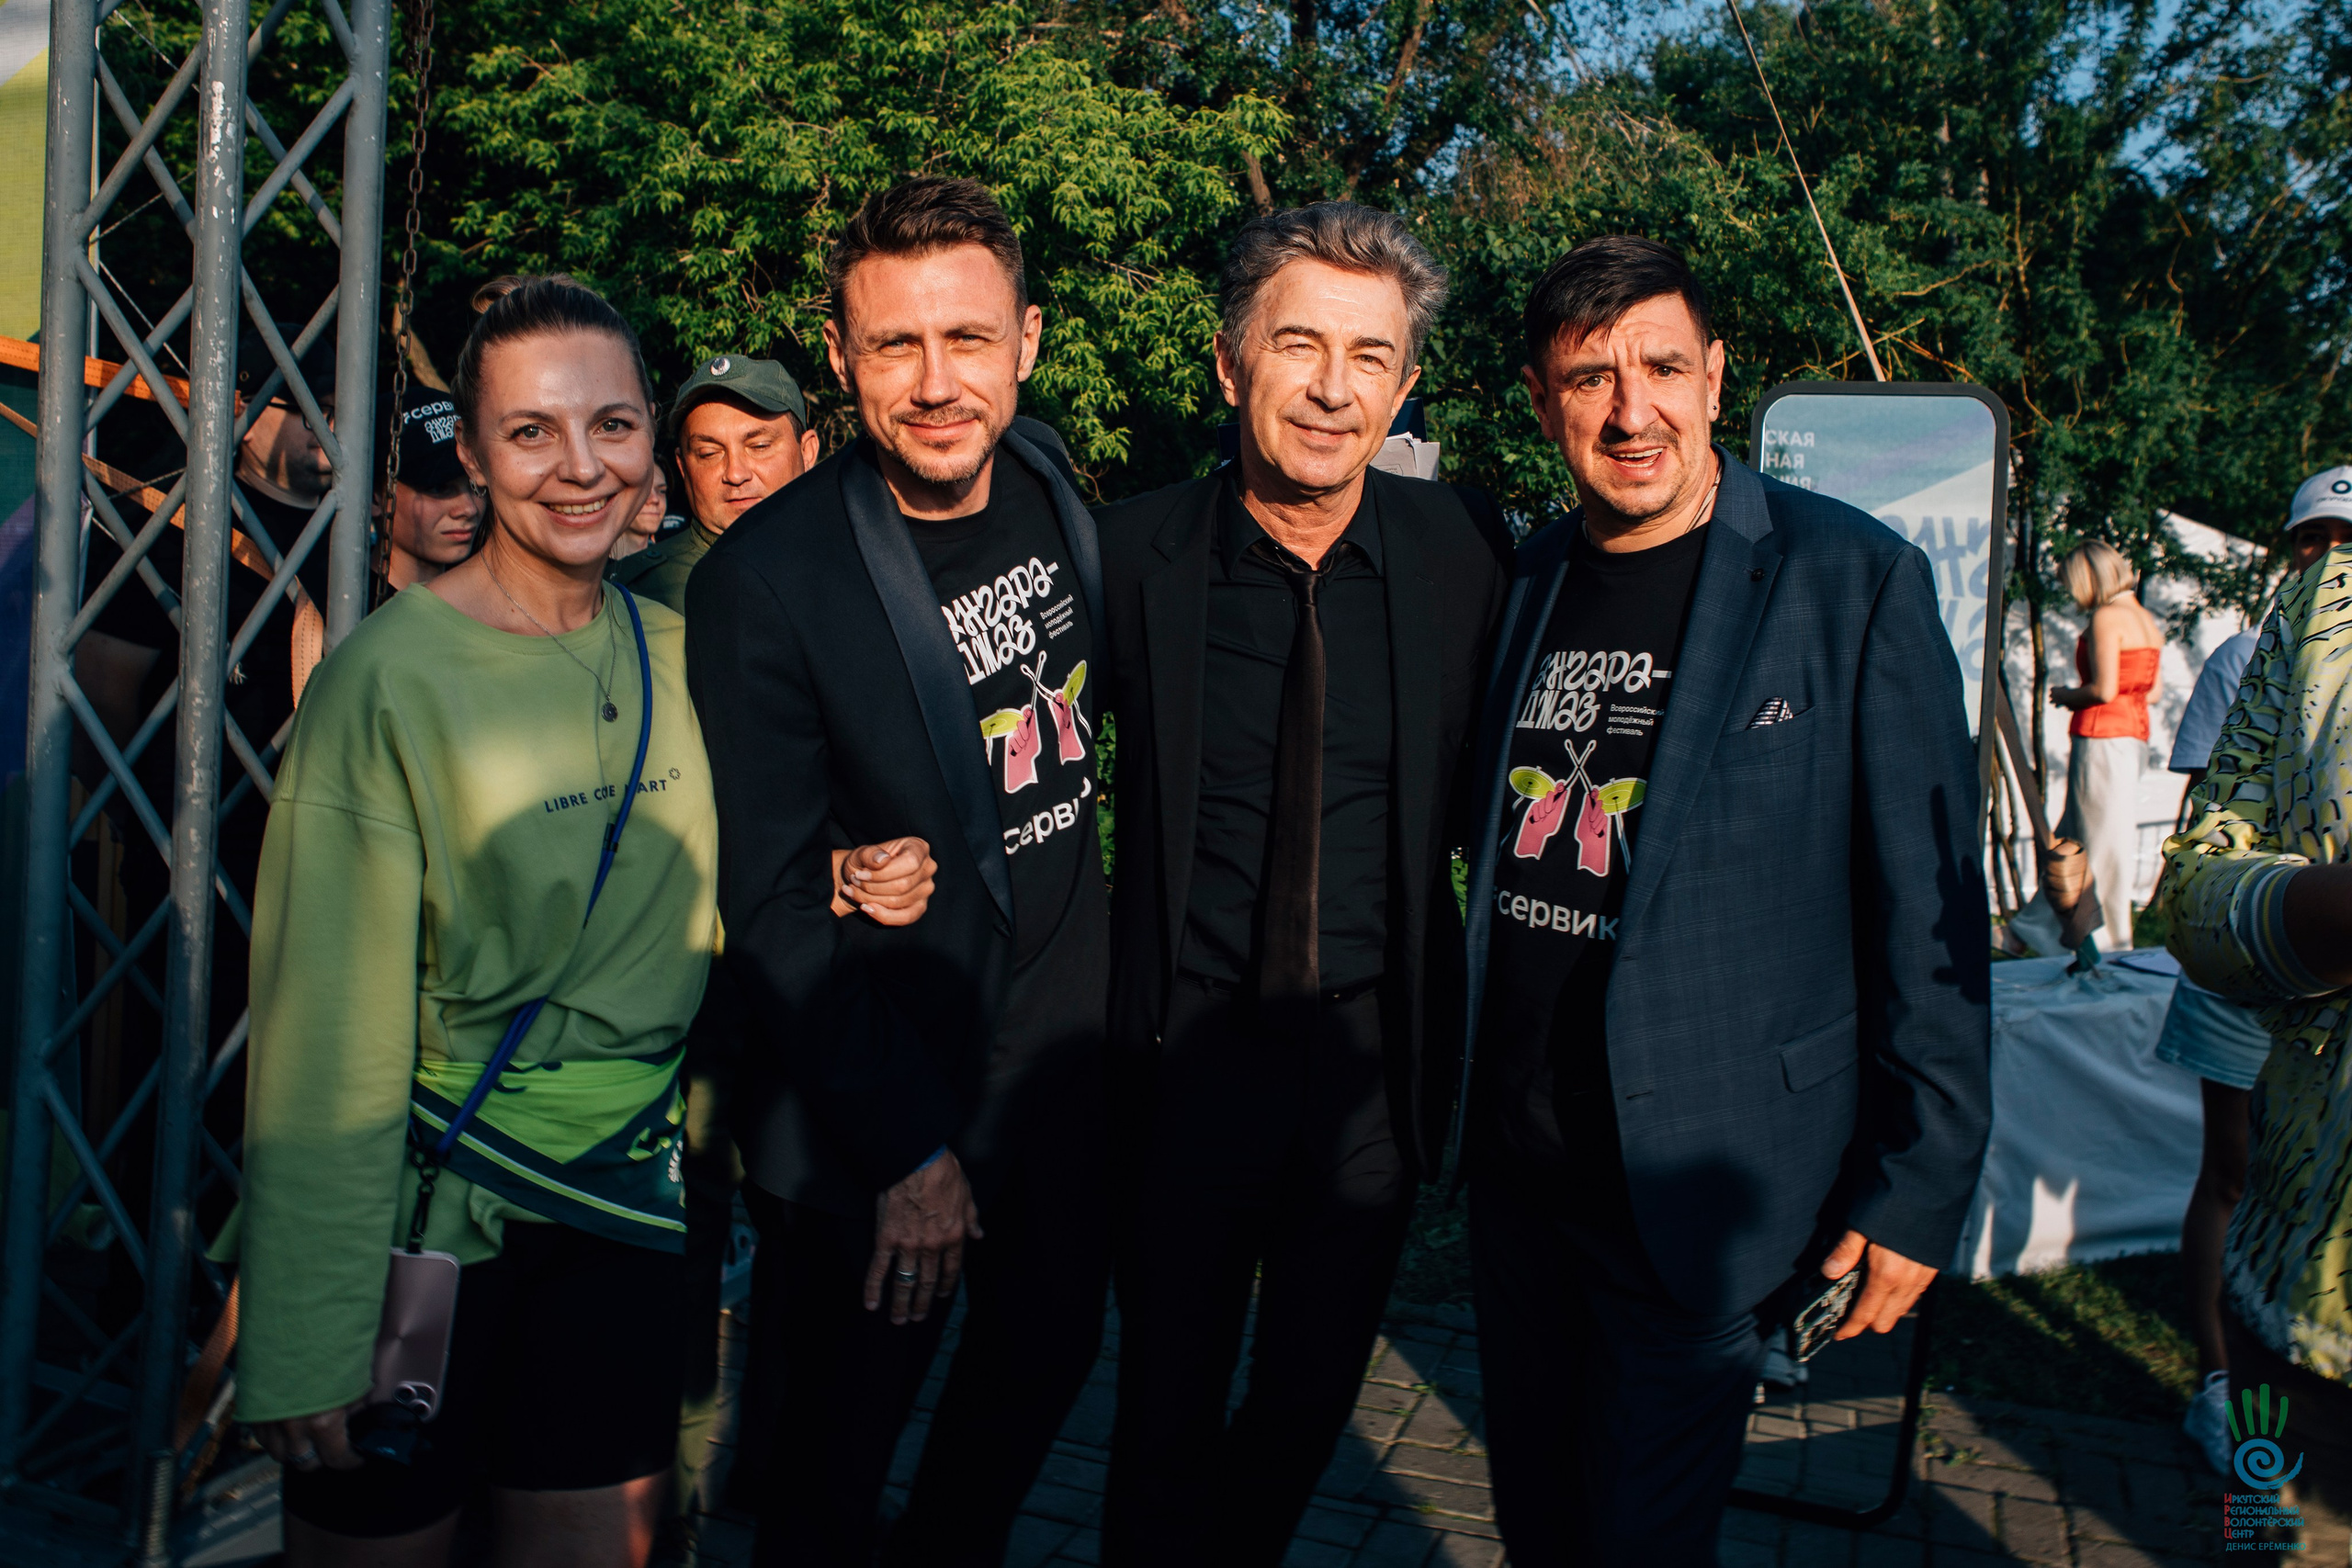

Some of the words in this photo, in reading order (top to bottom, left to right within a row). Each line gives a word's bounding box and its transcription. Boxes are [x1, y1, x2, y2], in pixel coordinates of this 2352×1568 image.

[1765, 430, 1815, 447] СКАЯ
[1766, 452, 1804, 468] НАЯ
[544, 792, 588, 813] LIBRE
